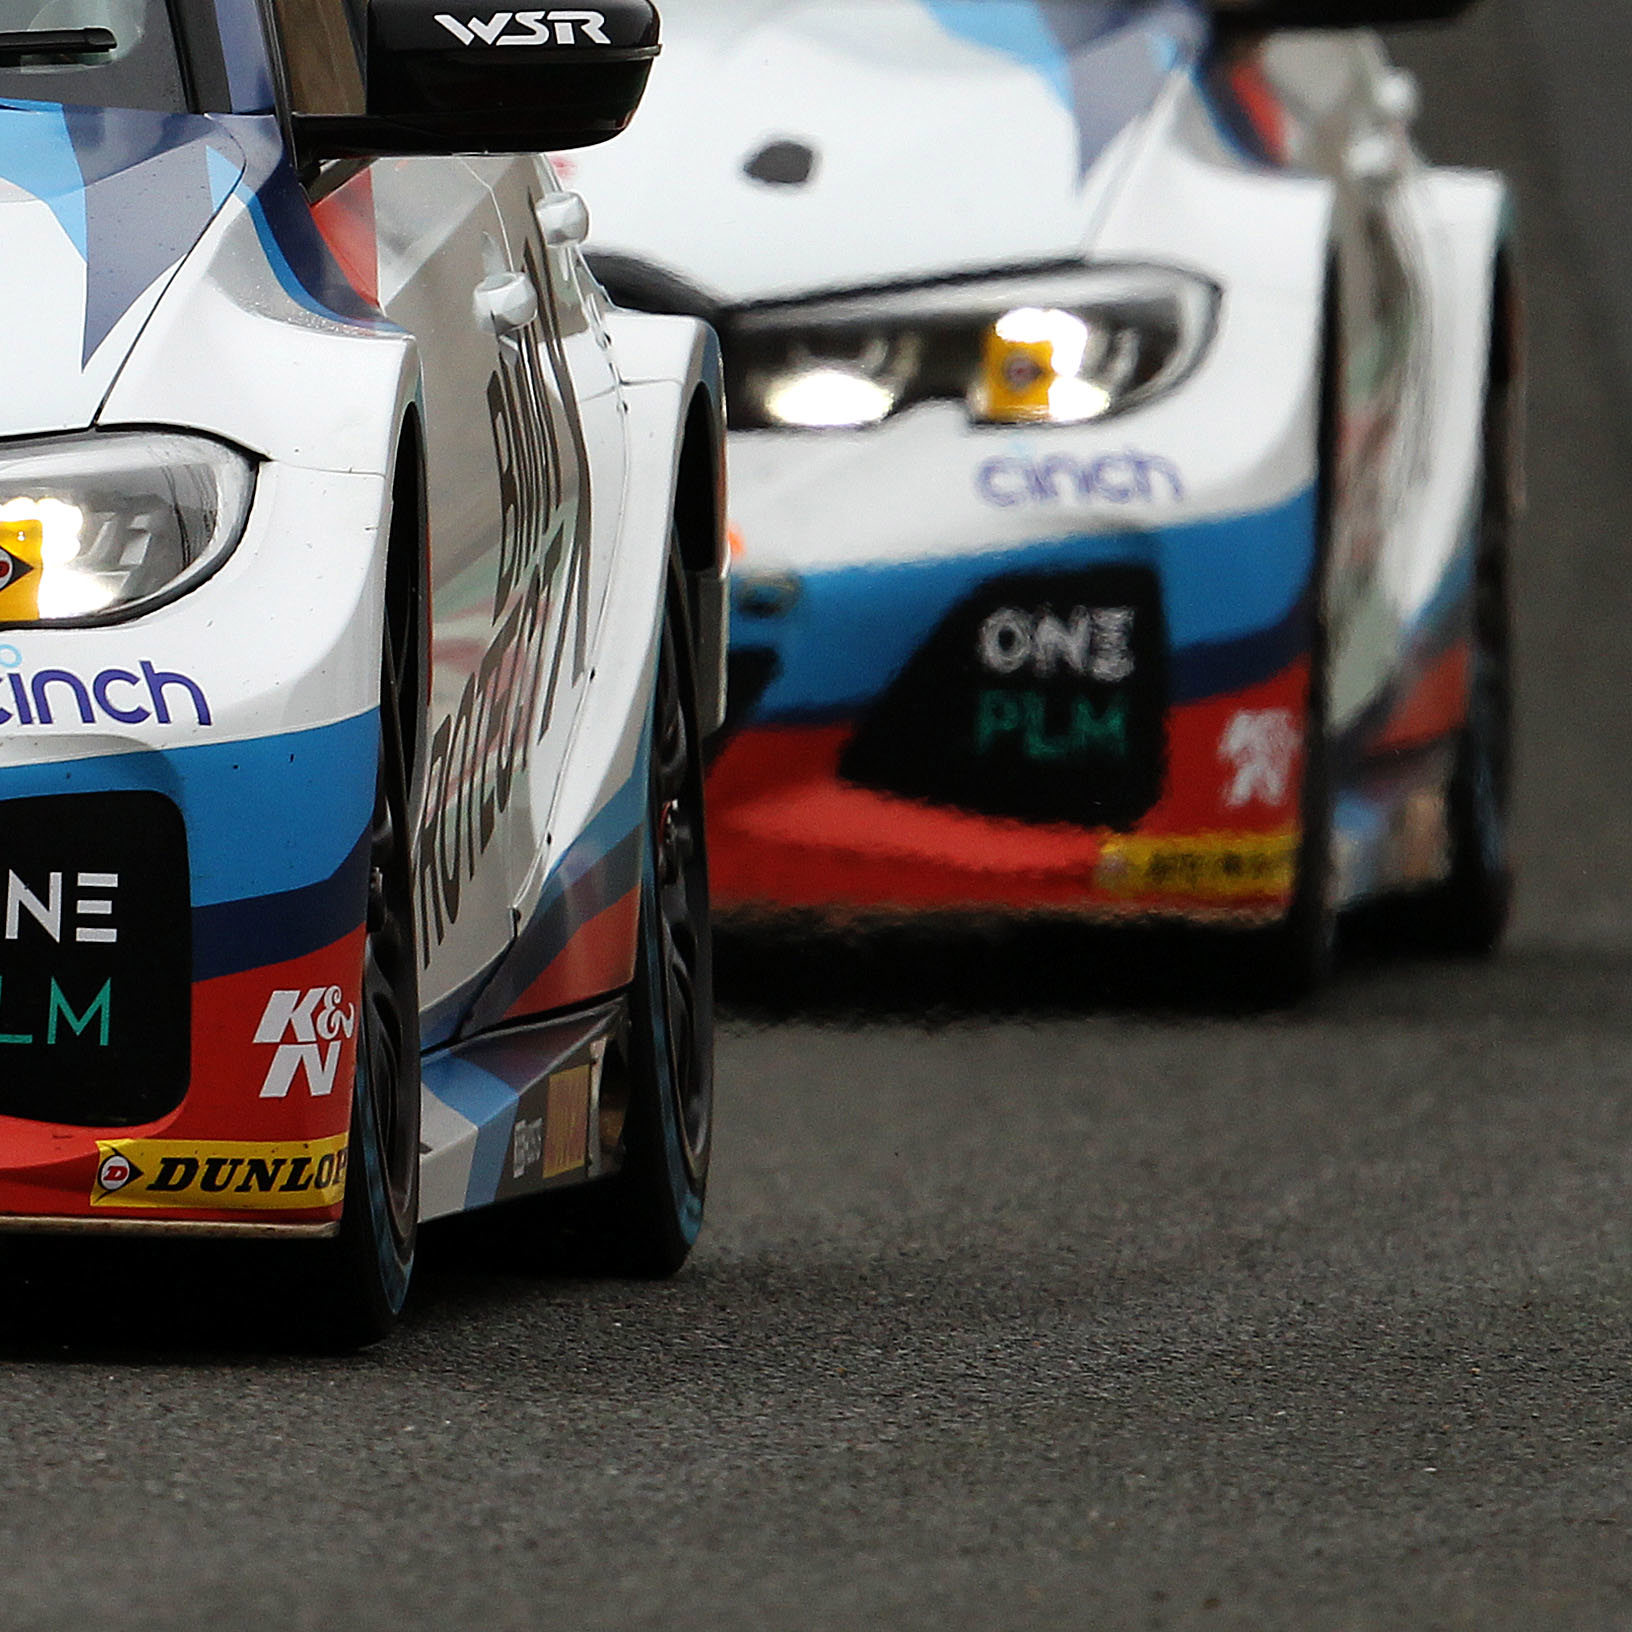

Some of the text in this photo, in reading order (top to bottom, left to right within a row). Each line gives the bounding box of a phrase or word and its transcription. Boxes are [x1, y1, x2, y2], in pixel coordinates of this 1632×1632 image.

[433, 8, 612, 46] WSR
[978, 603, 1136, 682] ONE
[974, 689, 1128, 758] PLM
